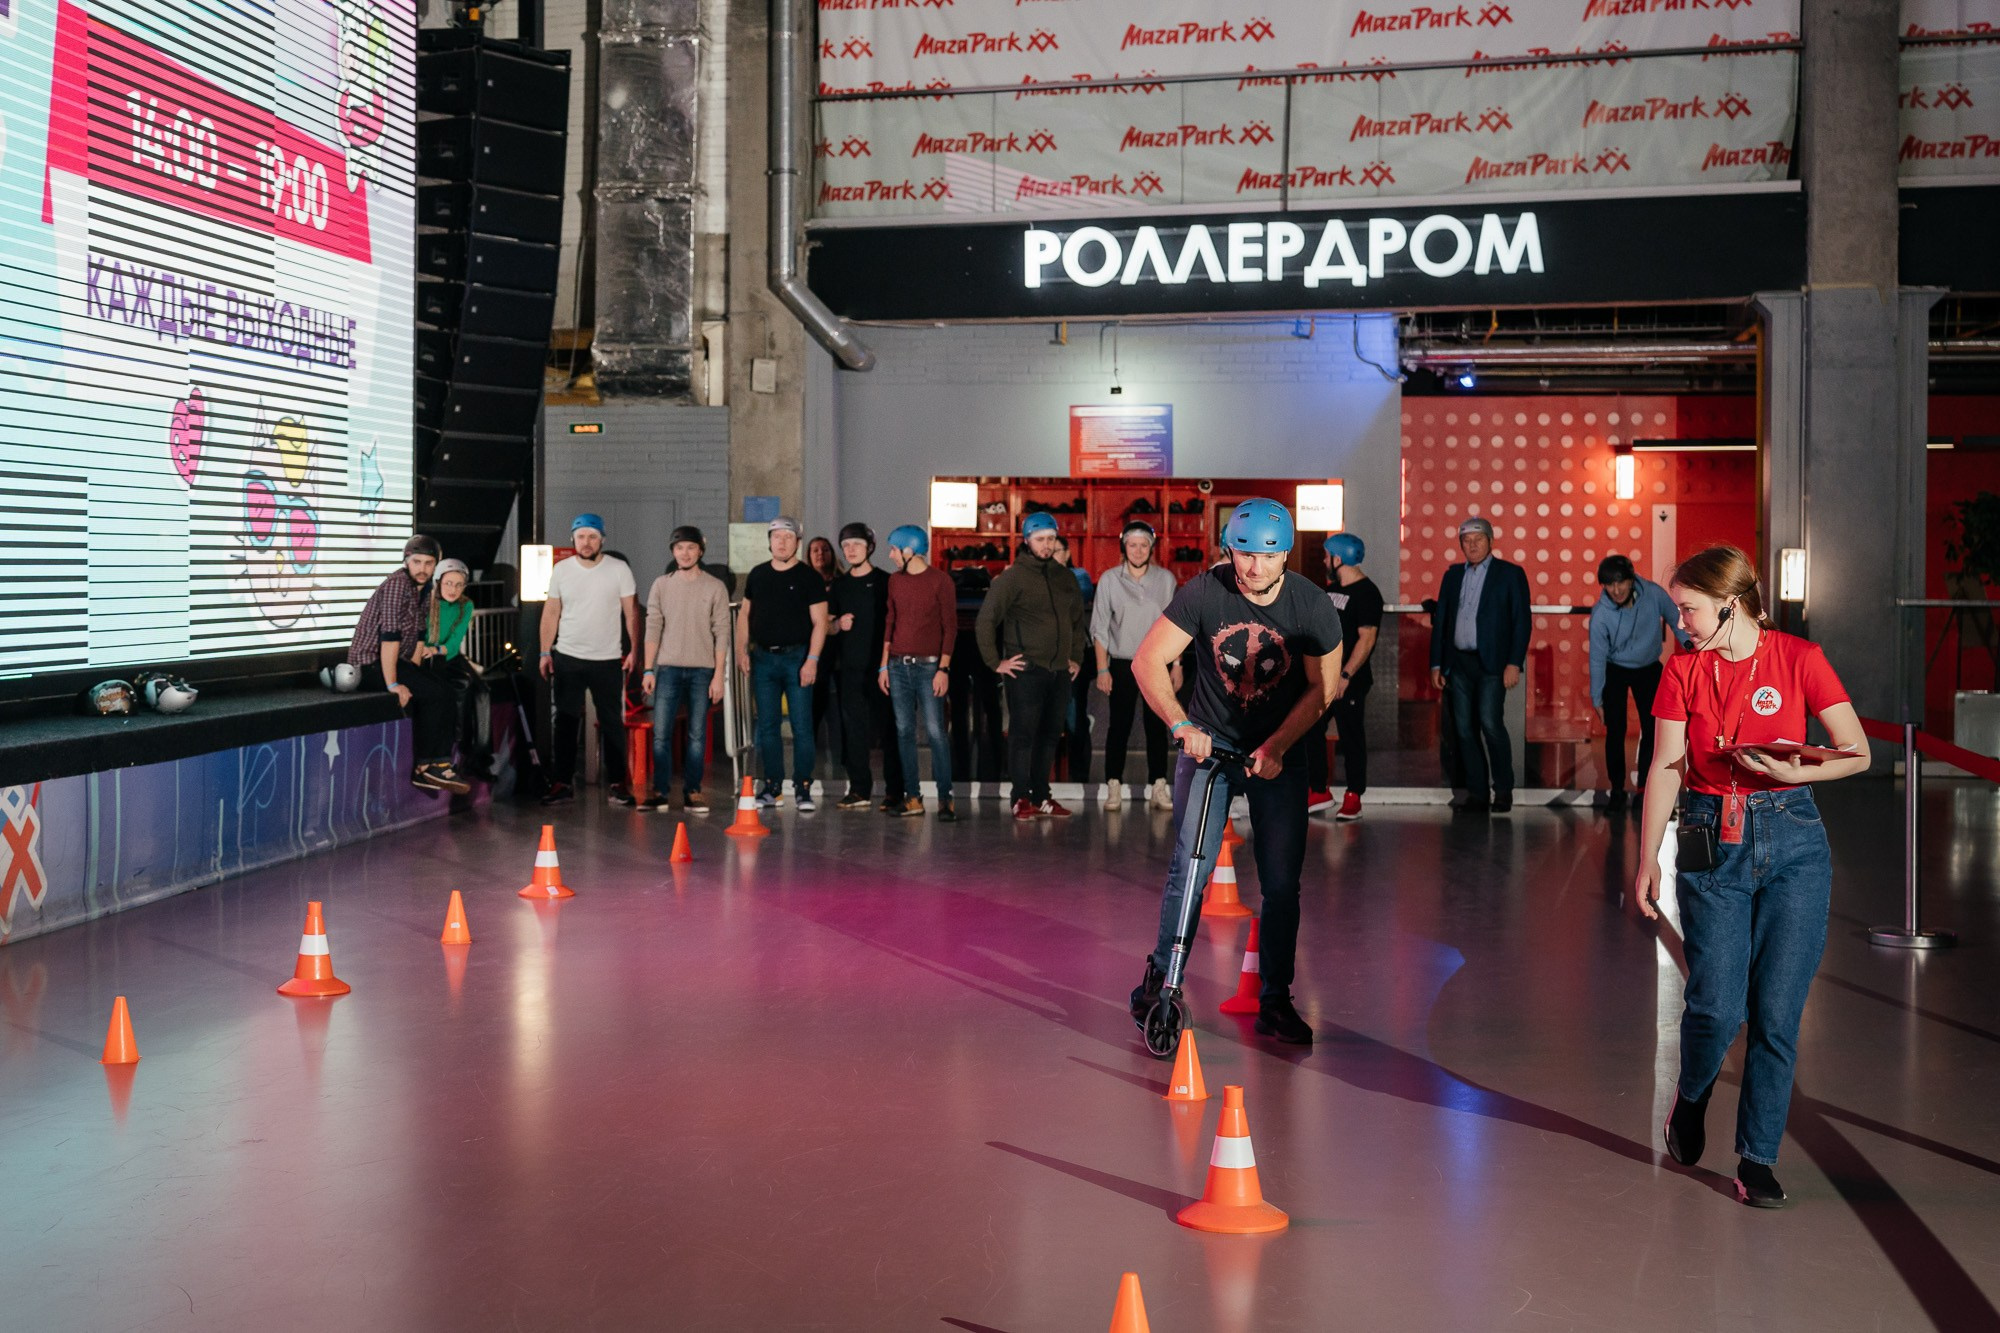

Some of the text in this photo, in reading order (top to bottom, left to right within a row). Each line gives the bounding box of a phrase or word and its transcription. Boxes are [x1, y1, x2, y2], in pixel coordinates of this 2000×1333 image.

[1119, 20, 1236, 51] MazaPark
[1350, 5, 1473, 38] MazaPark
[913, 31, 1023, 59] MazaPark
[1350, 111, 1471, 142] MazaPark
[1583, 97, 1708, 127] MazaPark
[912, 131, 1021, 157] MazaPark
[1120, 123, 1234, 152] MazaPark
[126, 90, 218, 193] 14:00
[255, 141, 329, 231] 19:00
[1465, 153, 1587, 183] MazaPark
[818, 180, 917, 206] MazaPark
[1015, 175, 1127, 201] MazaPark
[1236, 165, 1355, 193] MazaPark
[1024, 212, 1545, 288] РОЛЛЕРДРОМ
[87, 253, 357, 370] КАЖДЫЕ ВЫХОДНЫЕ
